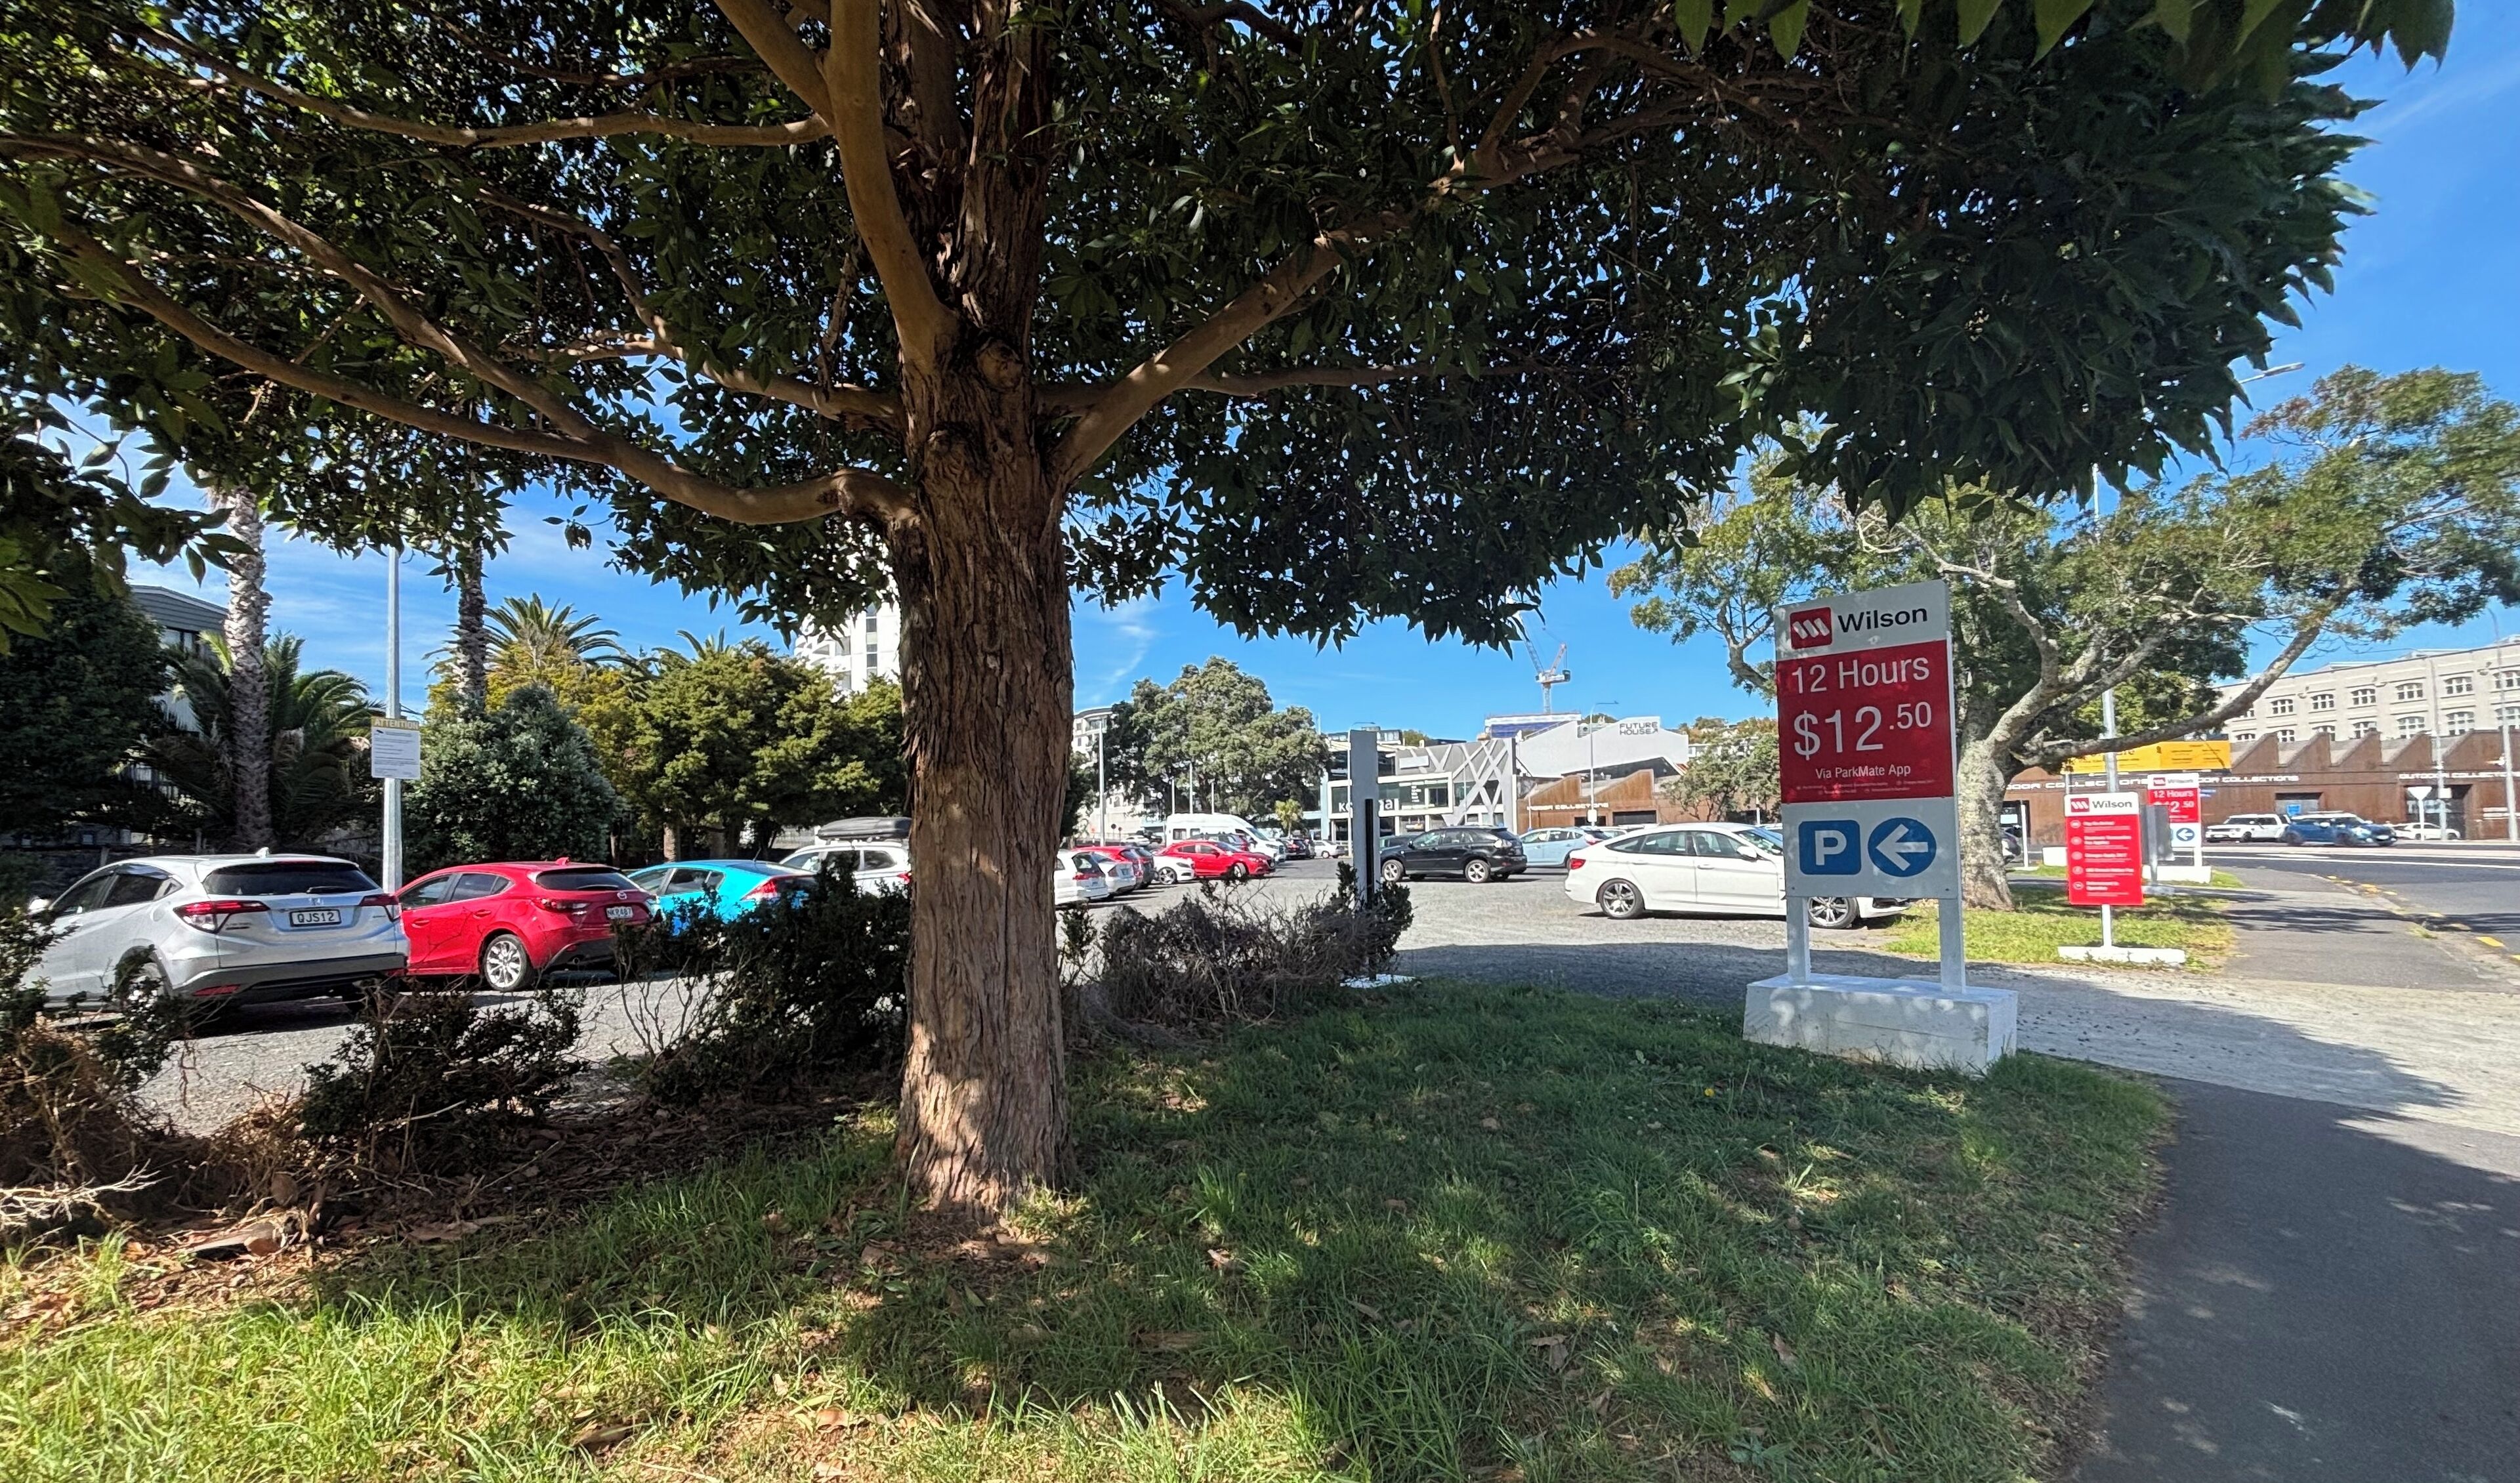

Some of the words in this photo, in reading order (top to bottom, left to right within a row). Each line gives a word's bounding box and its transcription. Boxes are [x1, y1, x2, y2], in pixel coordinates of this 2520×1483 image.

[1838, 608, 1927, 633] Wilson
[1792, 664, 1827, 694] 12
[1839, 657, 1929, 689] Hours
[1815, 768, 1832, 780] Via
[1835, 765, 1885, 778] ParkMate
[1888, 764, 1911, 777] App
[1815, 829, 1847, 866] P
[297, 911, 335, 923] QJS12
